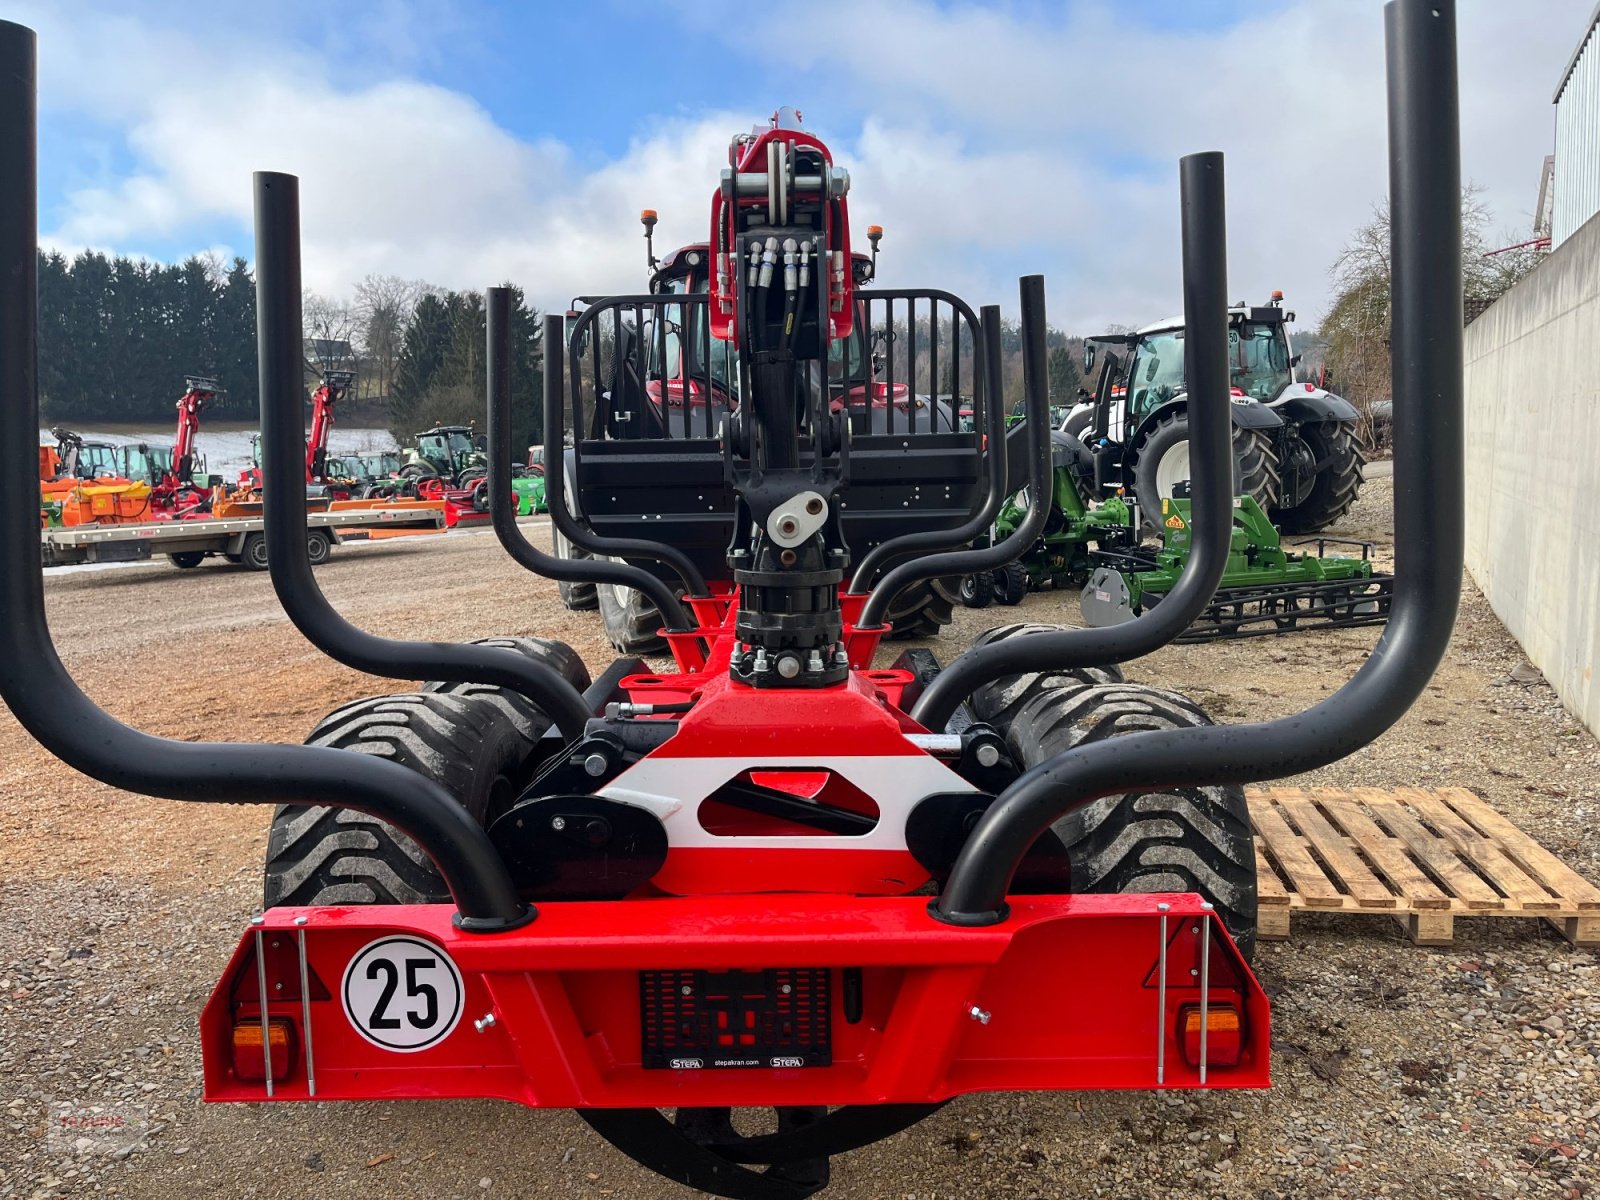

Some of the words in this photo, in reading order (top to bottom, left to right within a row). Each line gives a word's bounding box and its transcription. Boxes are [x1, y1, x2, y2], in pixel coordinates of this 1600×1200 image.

[366, 958, 438, 1029] 25
[672, 1059, 701, 1069] STEPA
[714, 1059, 760, 1067] stepakran.com
[773, 1058, 801, 1067] STEPA
